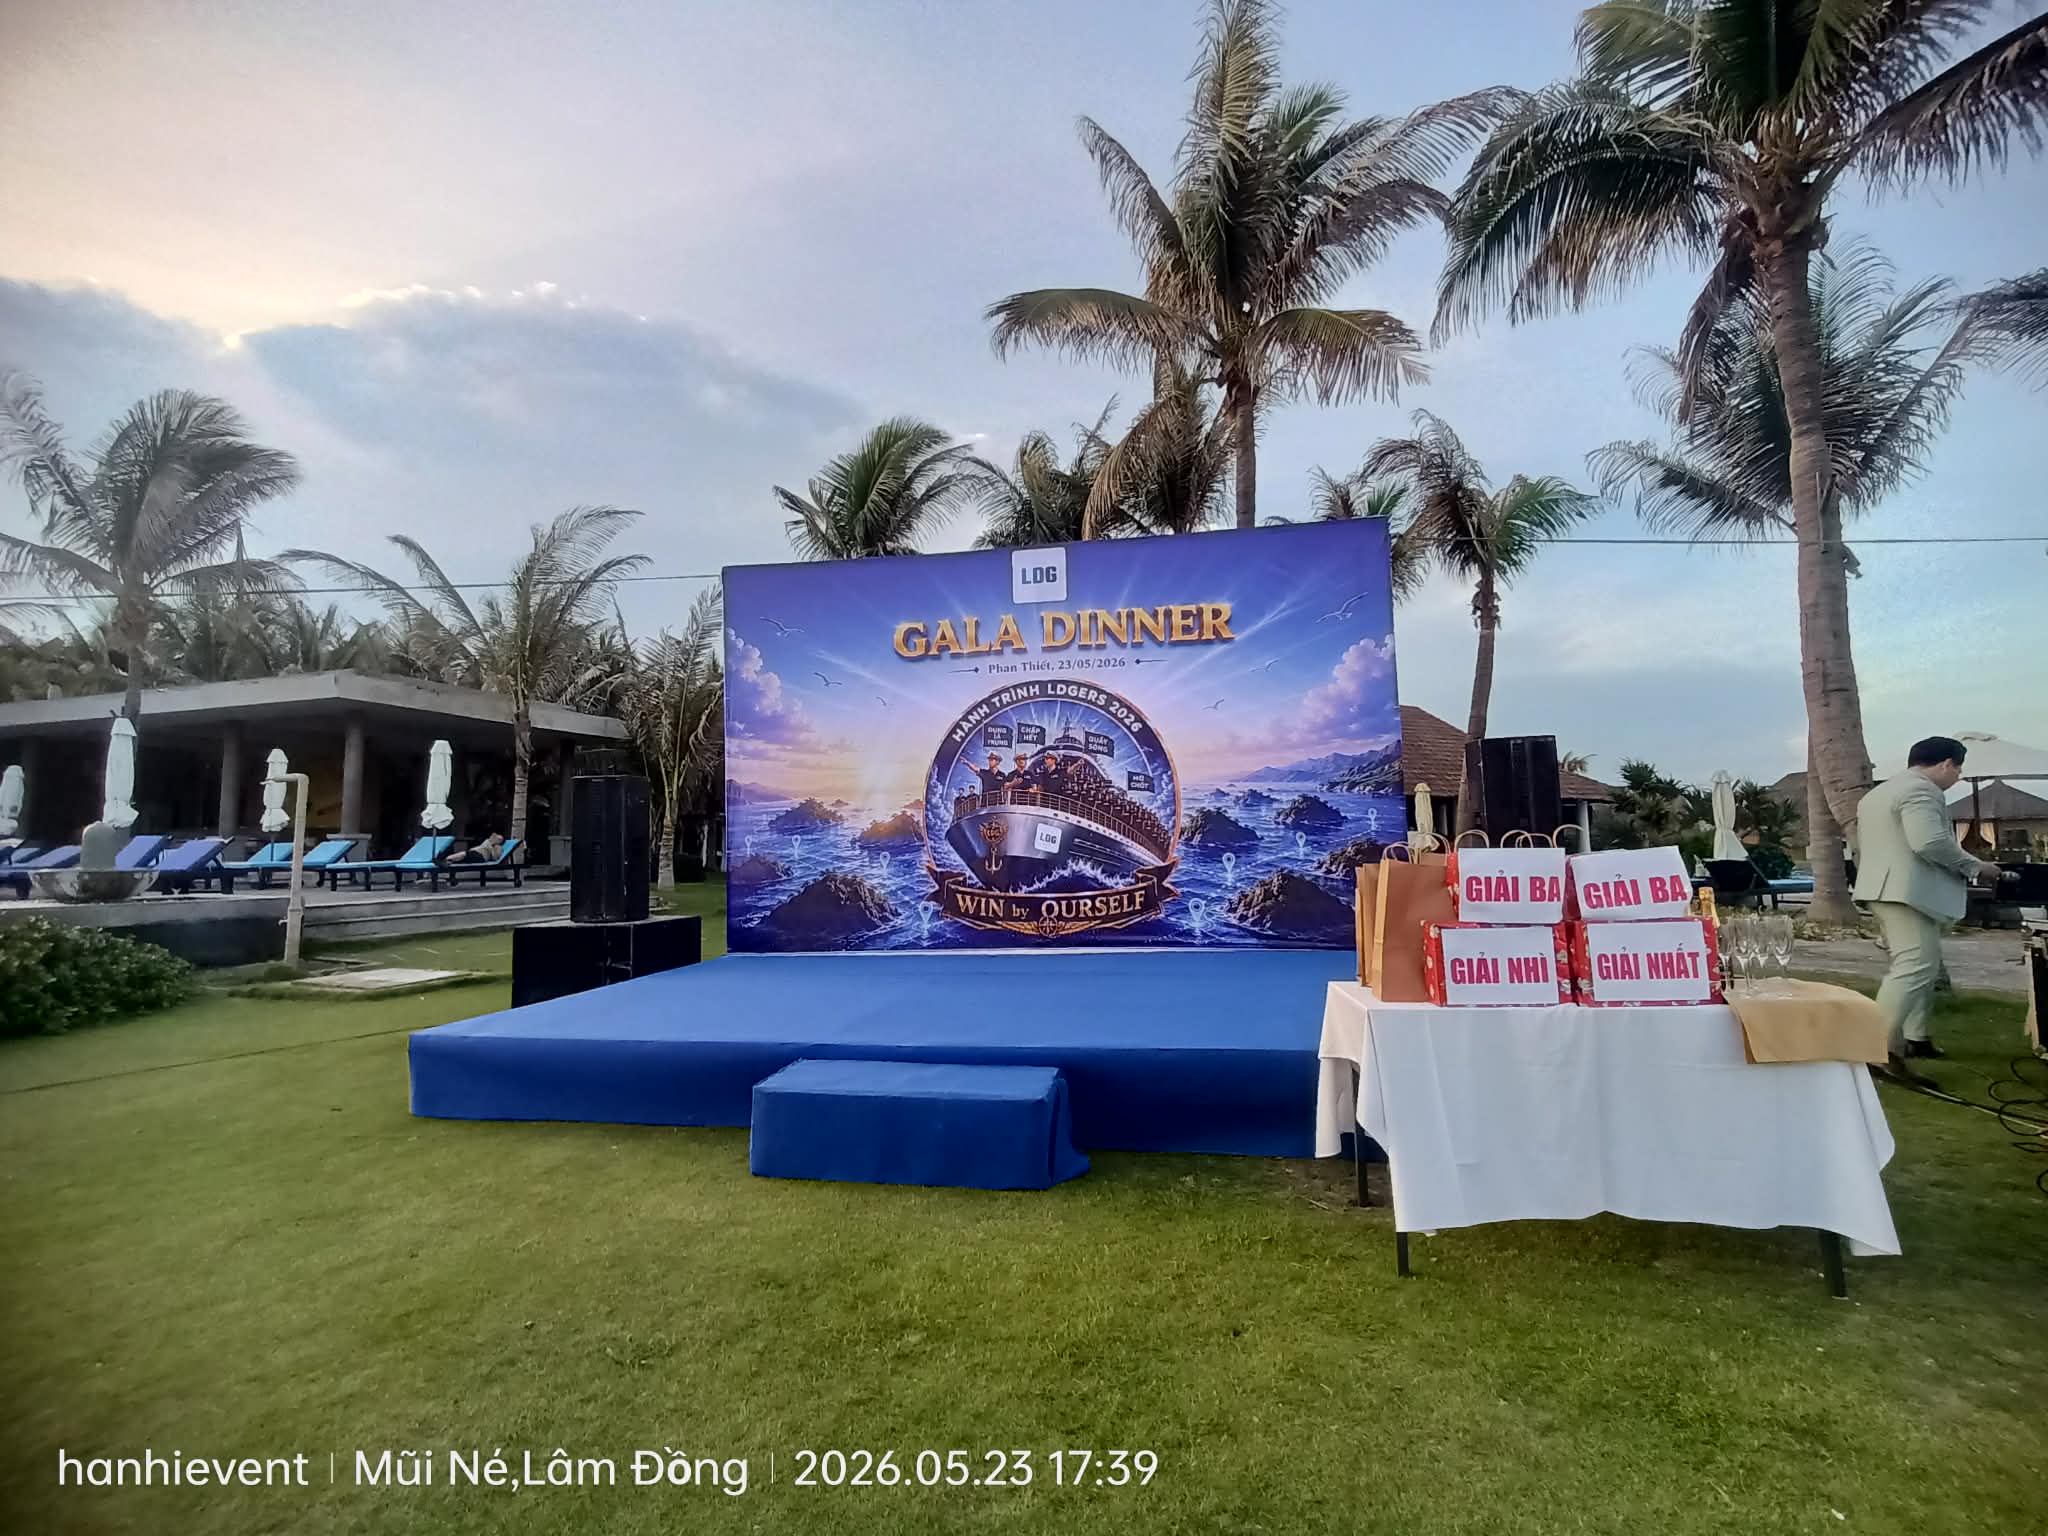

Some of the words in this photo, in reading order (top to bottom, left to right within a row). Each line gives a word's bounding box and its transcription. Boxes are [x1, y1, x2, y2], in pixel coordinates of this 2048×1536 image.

[1021, 566, 1057, 585] LDG
[893, 613, 1028, 659] GALA
[1040, 602, 1236, 651] DINNER
[988, 663, 1018, 675] Phan
[1021, 660, 1055, 673] Thiết,
[1058, 657, 1126, 671] 23/05/2026
[1047, 683, 1107, 706] LDGERS
[1108, 701, 1143, 733] 2026
[1465, 869, 1520, 903] GIẢI
[1529, 875, 1562, 903] BA
[1583, 873, 1643, 910] GIẢI
[1648, 874, 1688, 904] BA
[956, 893, 1005, 917] WIN
[1012, 904, 1029, 919] by
[1041, 890, 1146, 919] OURSELF
[1450, 952, 1500, 985] GIẢI
[1507, 952, 1550, 985] NHÌ
[1596, 946, 1642, 981] GIẢI
[1646, 942, 1700, 981] NHẤT
